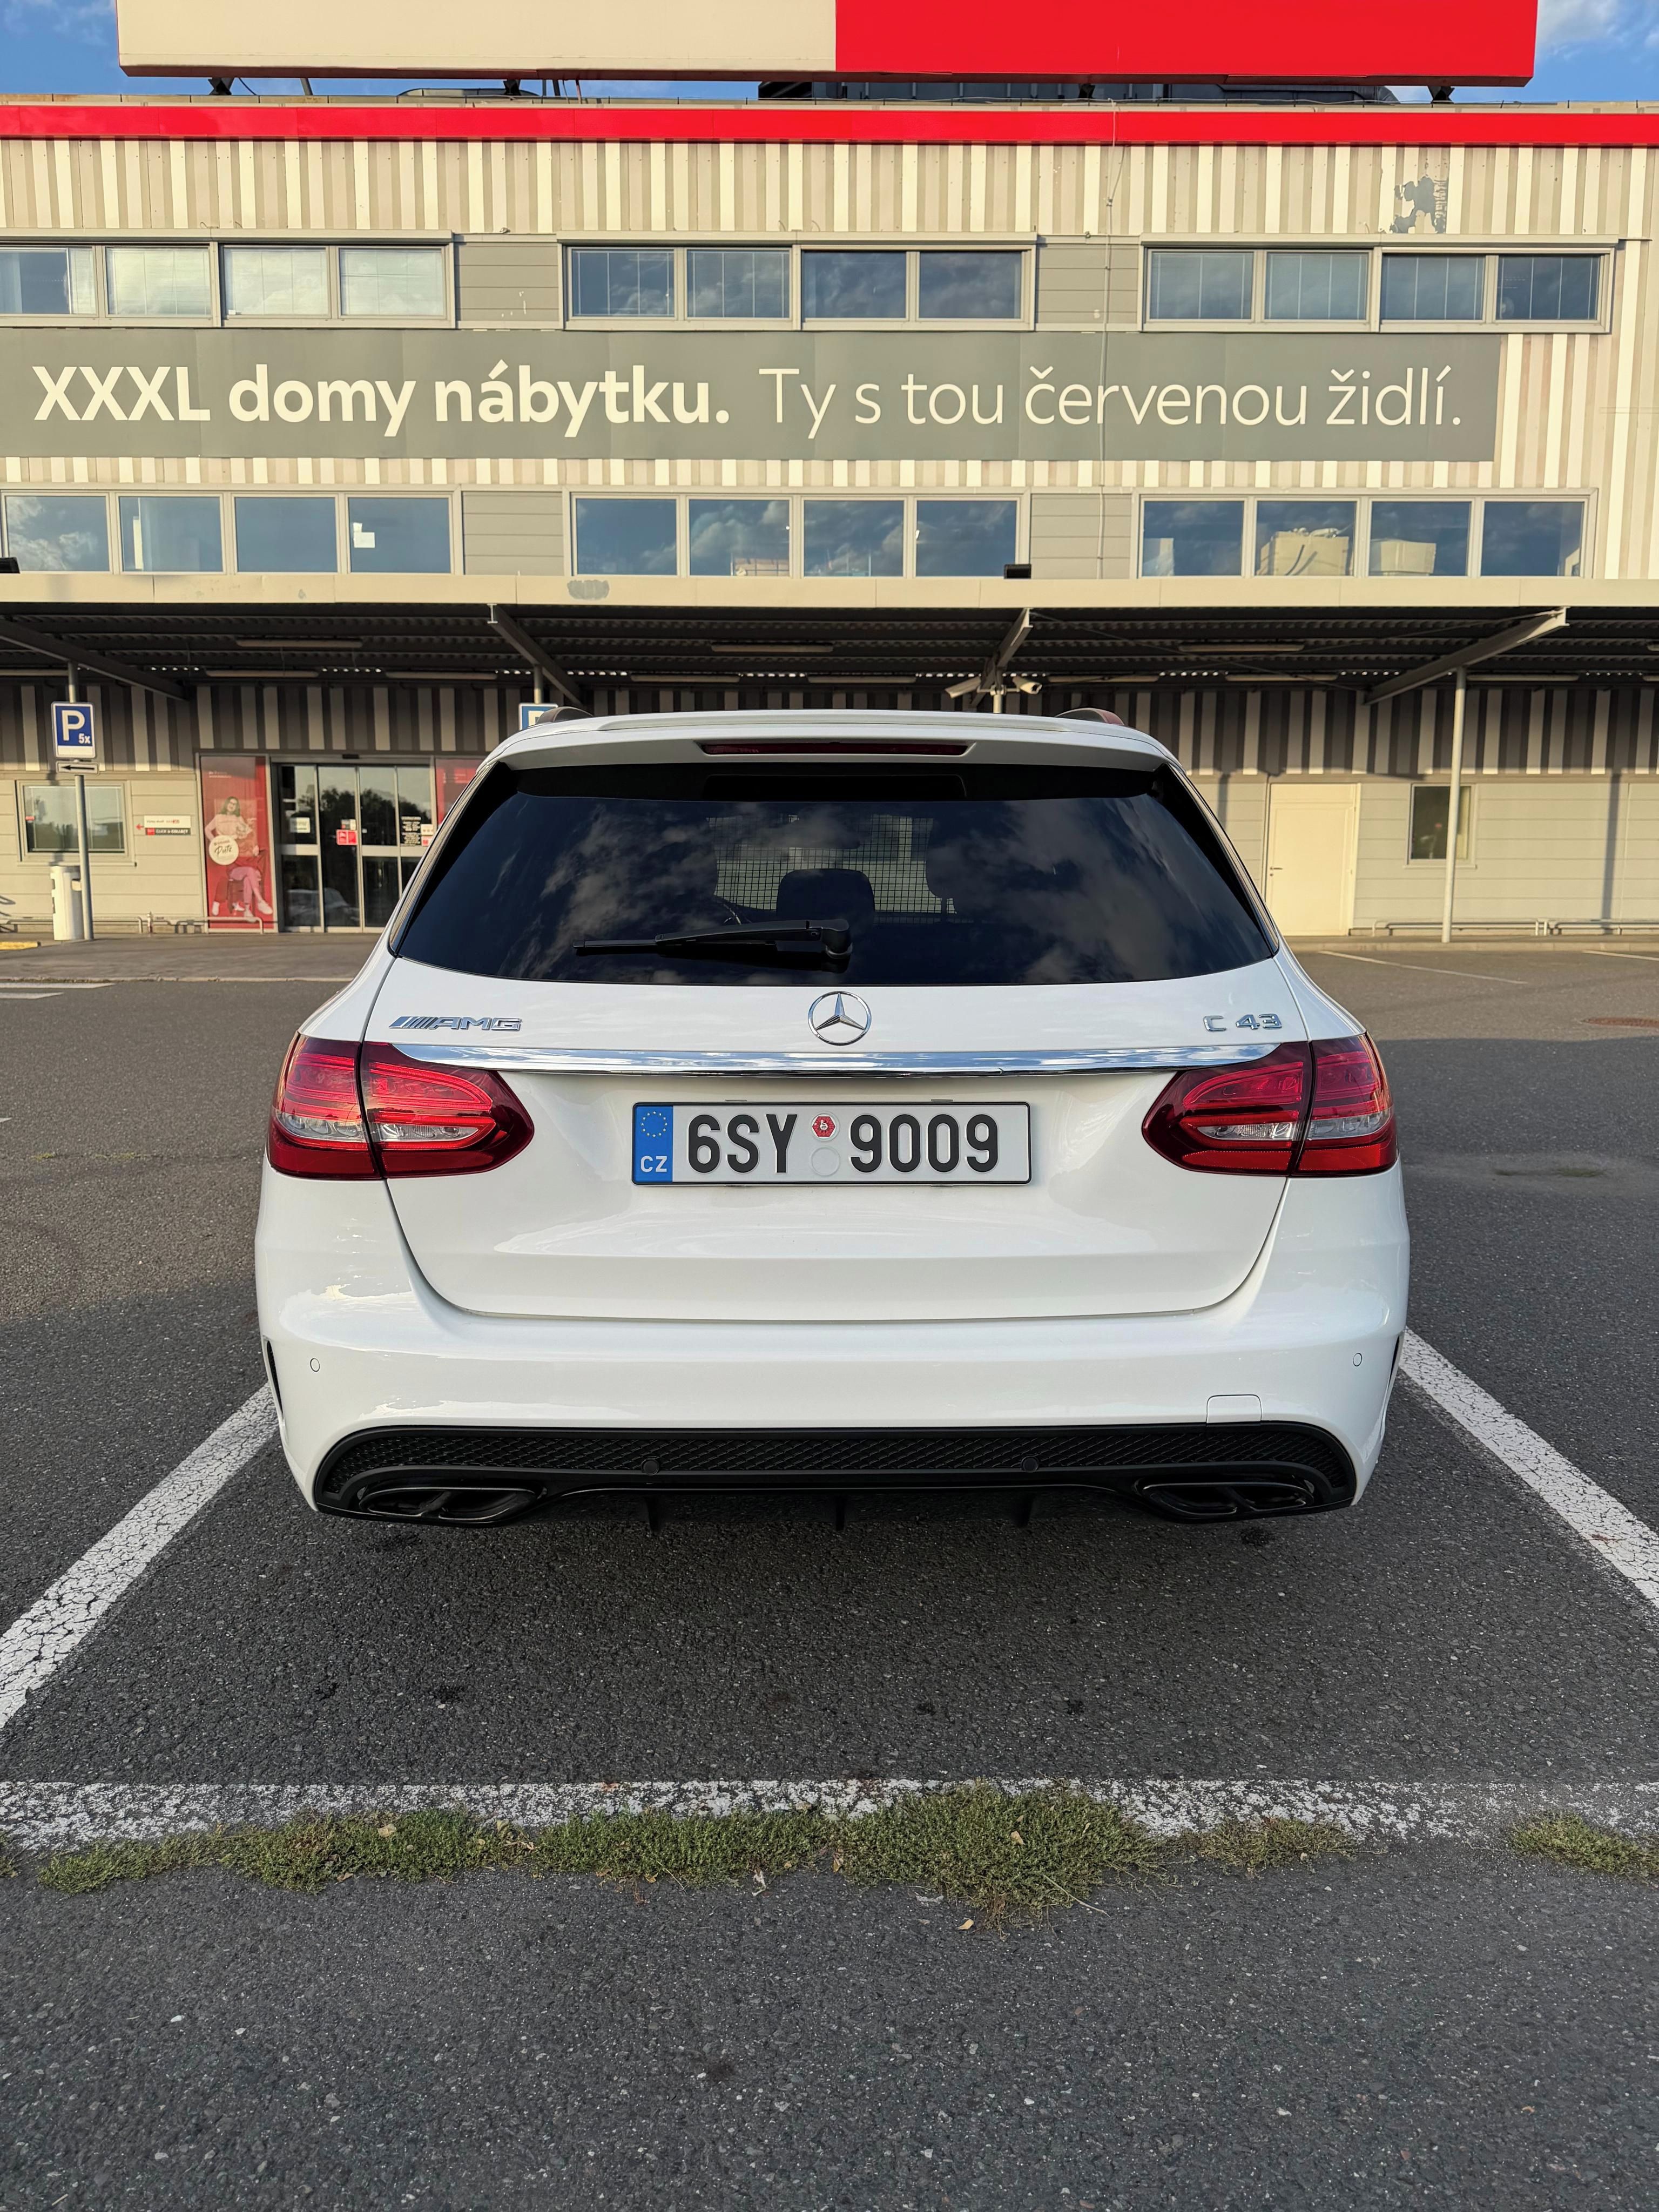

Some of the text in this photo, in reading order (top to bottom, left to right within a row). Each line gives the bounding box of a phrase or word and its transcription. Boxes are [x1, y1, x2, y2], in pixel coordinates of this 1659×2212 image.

[32, 359, 1460, 439] XXXL domy nábytku. Ty s tou červenou židlí.
[62, 710, 85, 741] P
[78, 733, 91, 744] 5x
[428, 1016, 522, 1031] AMG
[1203, 1013, 1283, 1032] C 43
[687, 1114, 999, 1174] 6SY 9009
[640, 1155, 667, 1172] CZ
